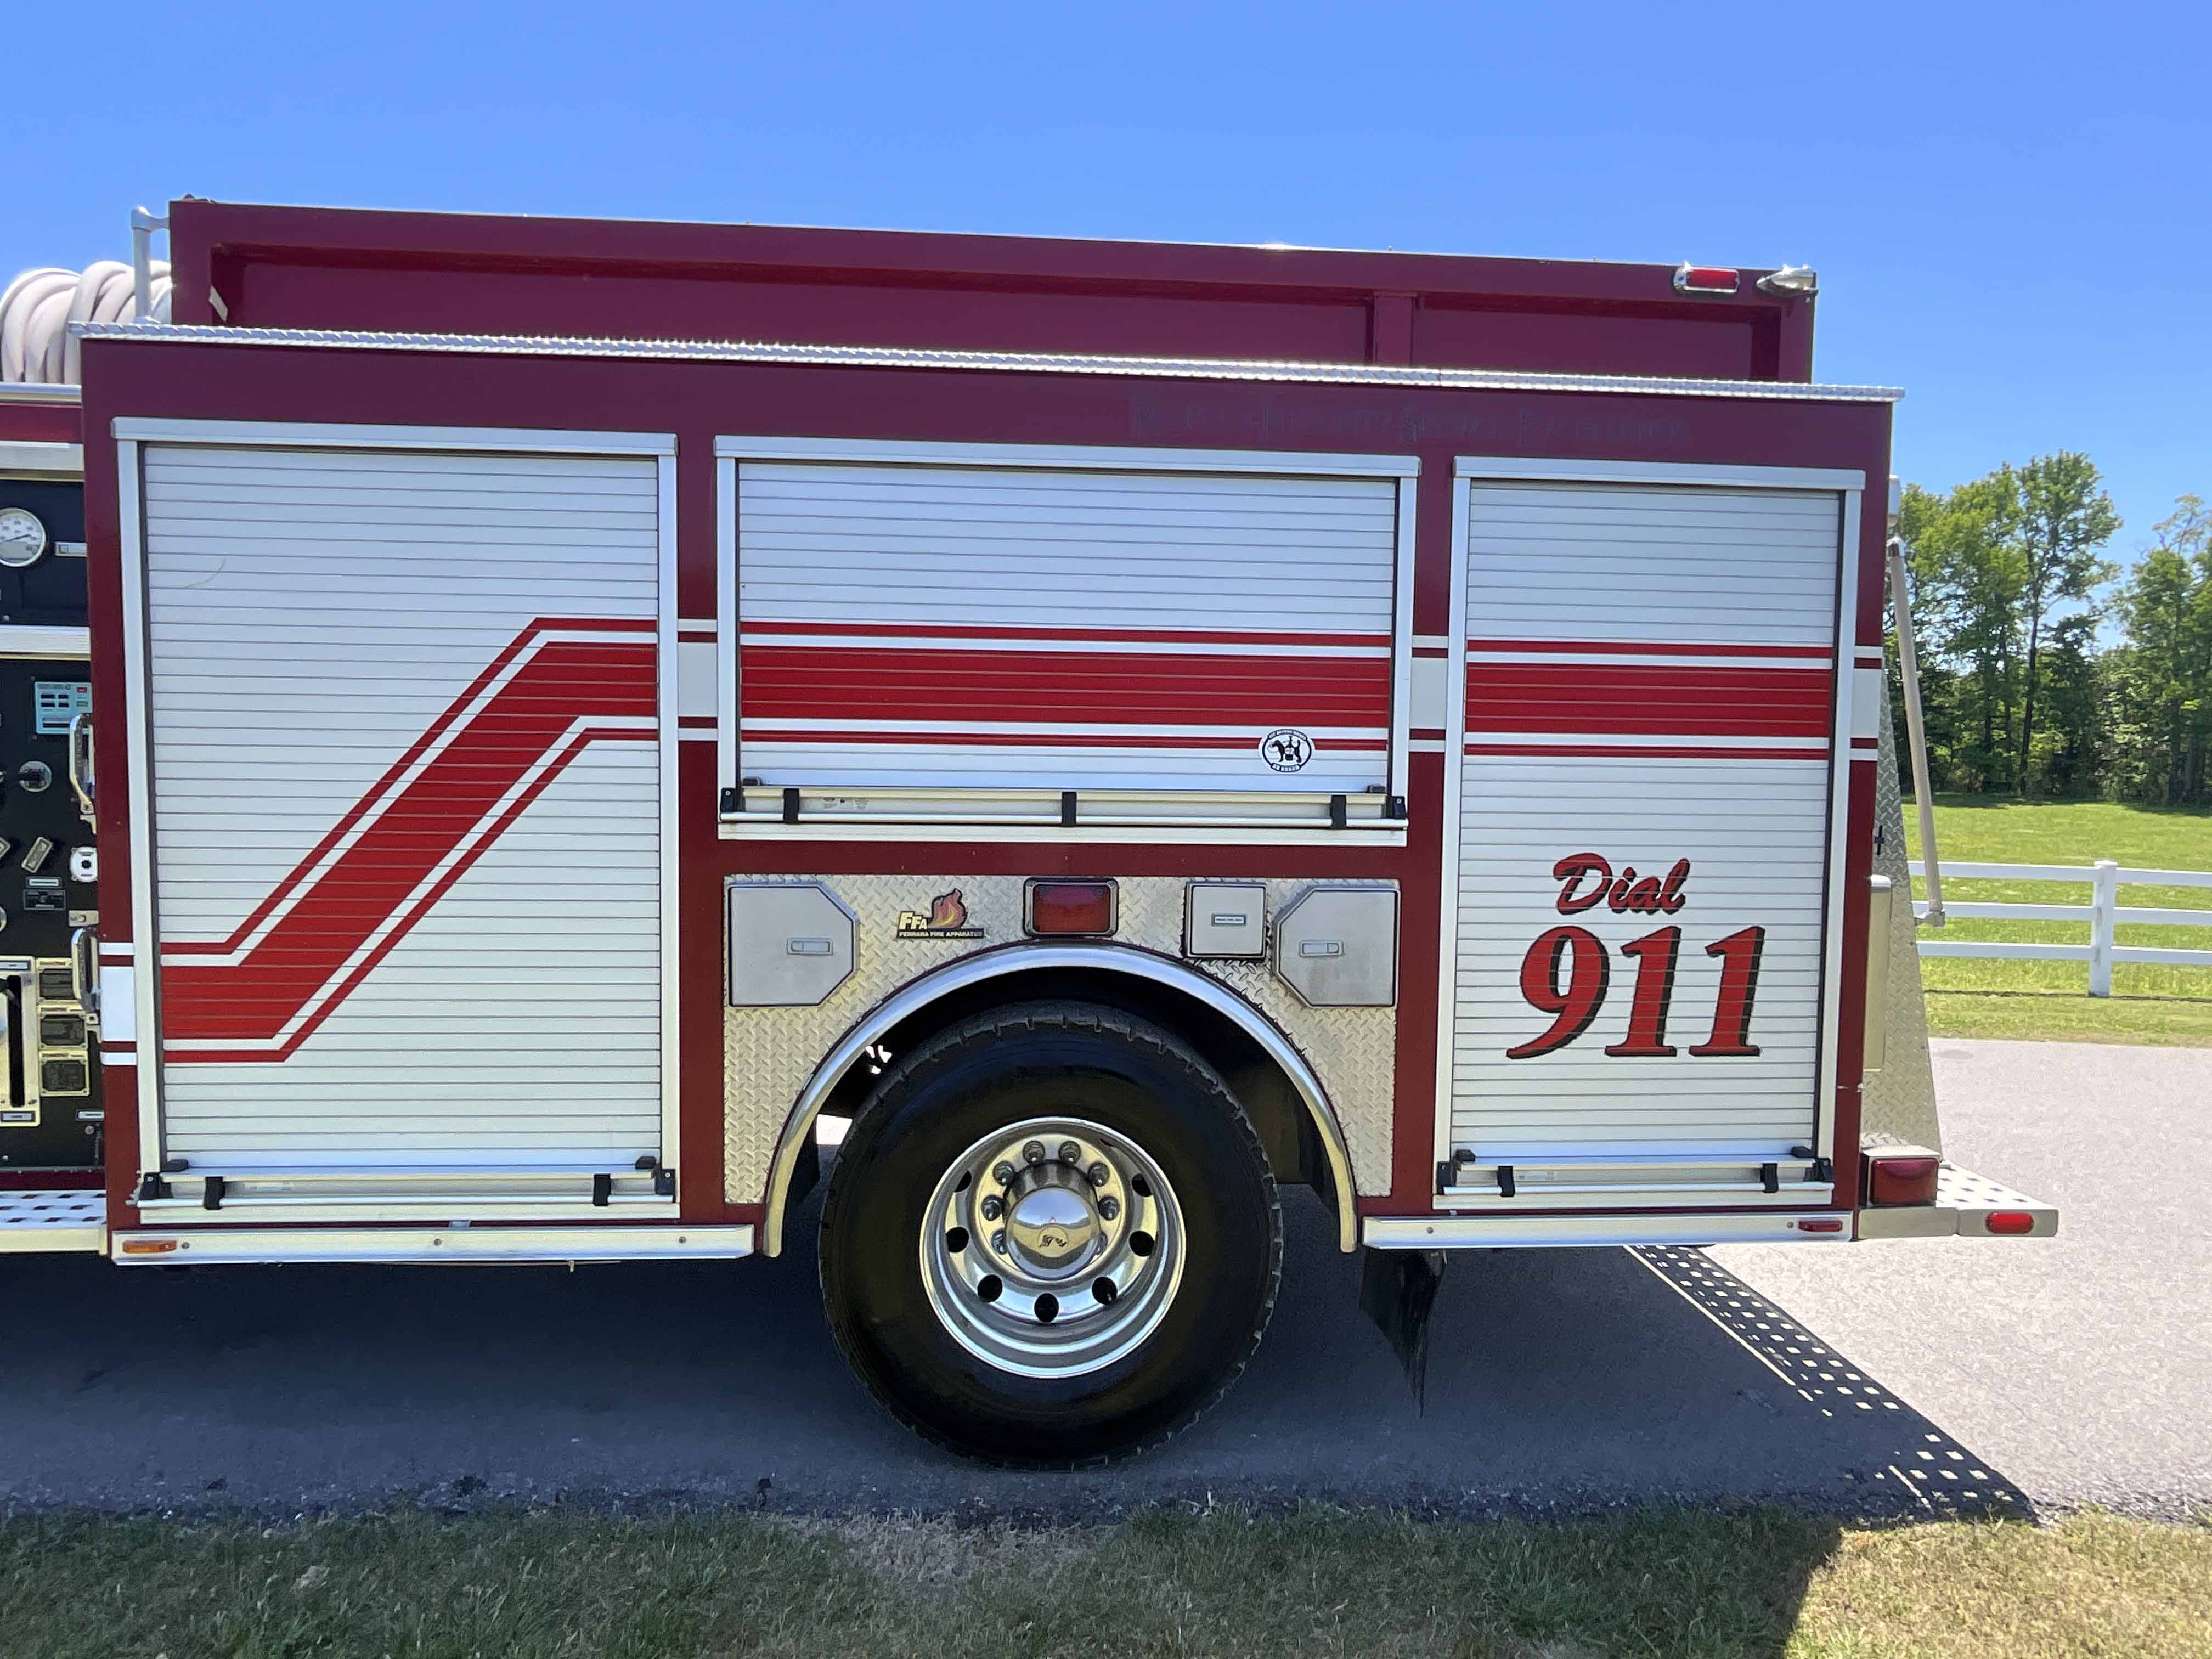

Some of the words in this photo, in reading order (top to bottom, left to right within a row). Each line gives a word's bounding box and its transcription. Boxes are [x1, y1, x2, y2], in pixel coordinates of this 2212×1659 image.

[1553, 853, 1690, 915] Dial
[899, 912, 928, 930] FFA
[1506, 925, 1765, 1059] 911
